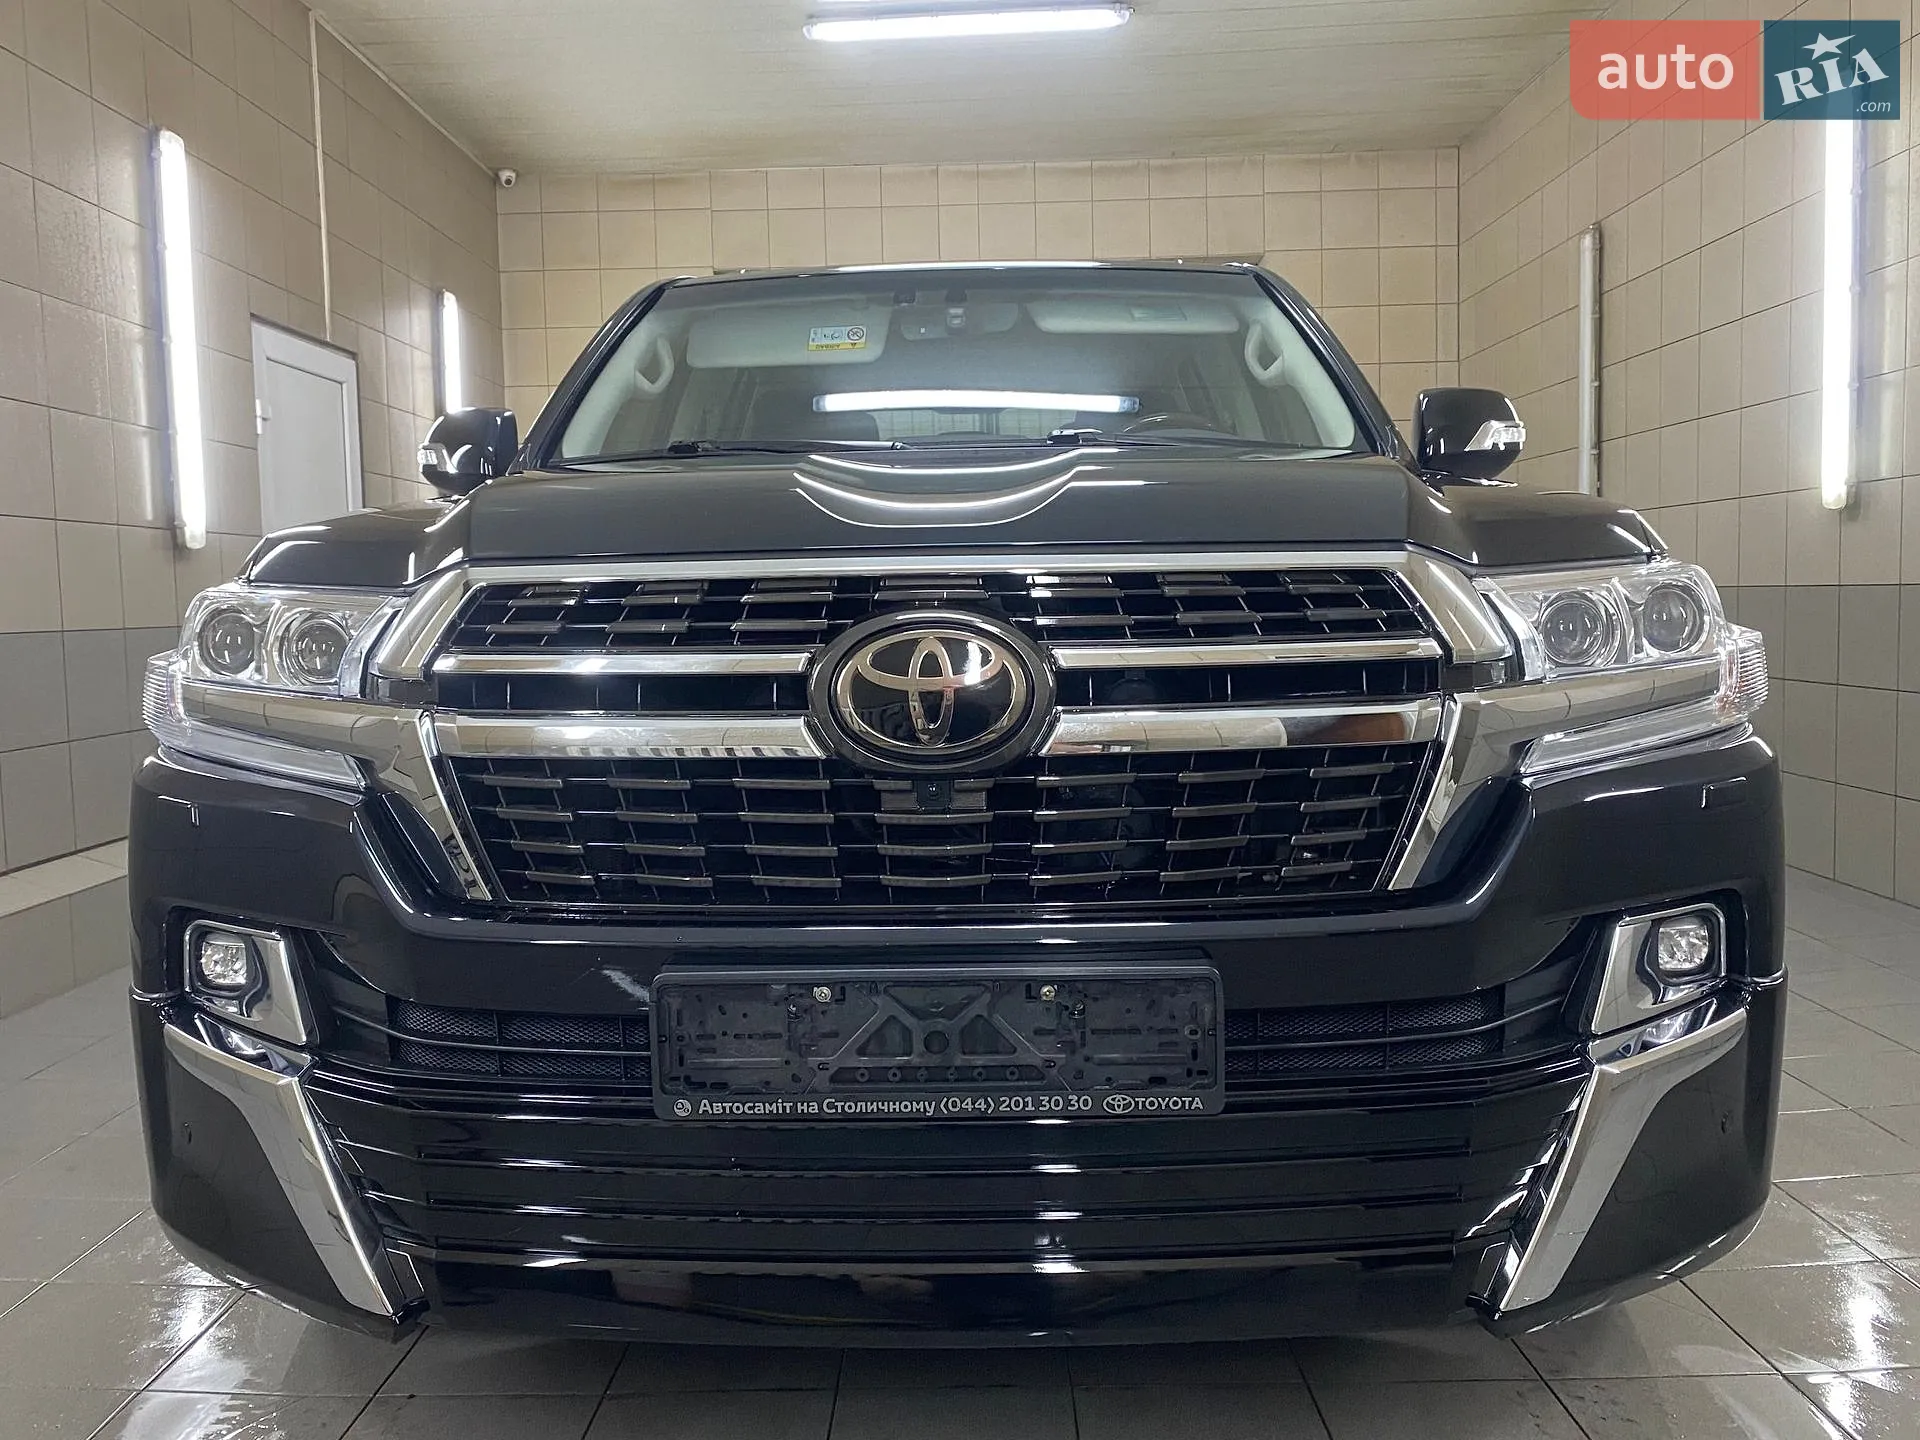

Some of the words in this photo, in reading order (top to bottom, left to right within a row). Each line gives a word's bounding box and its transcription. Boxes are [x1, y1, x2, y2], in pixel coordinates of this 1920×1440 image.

[698, 1098, 793, 1114] Автосаміт
[797, 1101, 819, 1113] на
[822, 1099, 936, 1116] Столичному
[939, 1096, 995, 1114] (044)
[998, 1096, 1035, 1111] 201
[1038, 1095, 1064, 1111] 30
[1067, 1095, 1093, 1111] 30
[1135, 1097, 1204, 1110] TOYOTA
